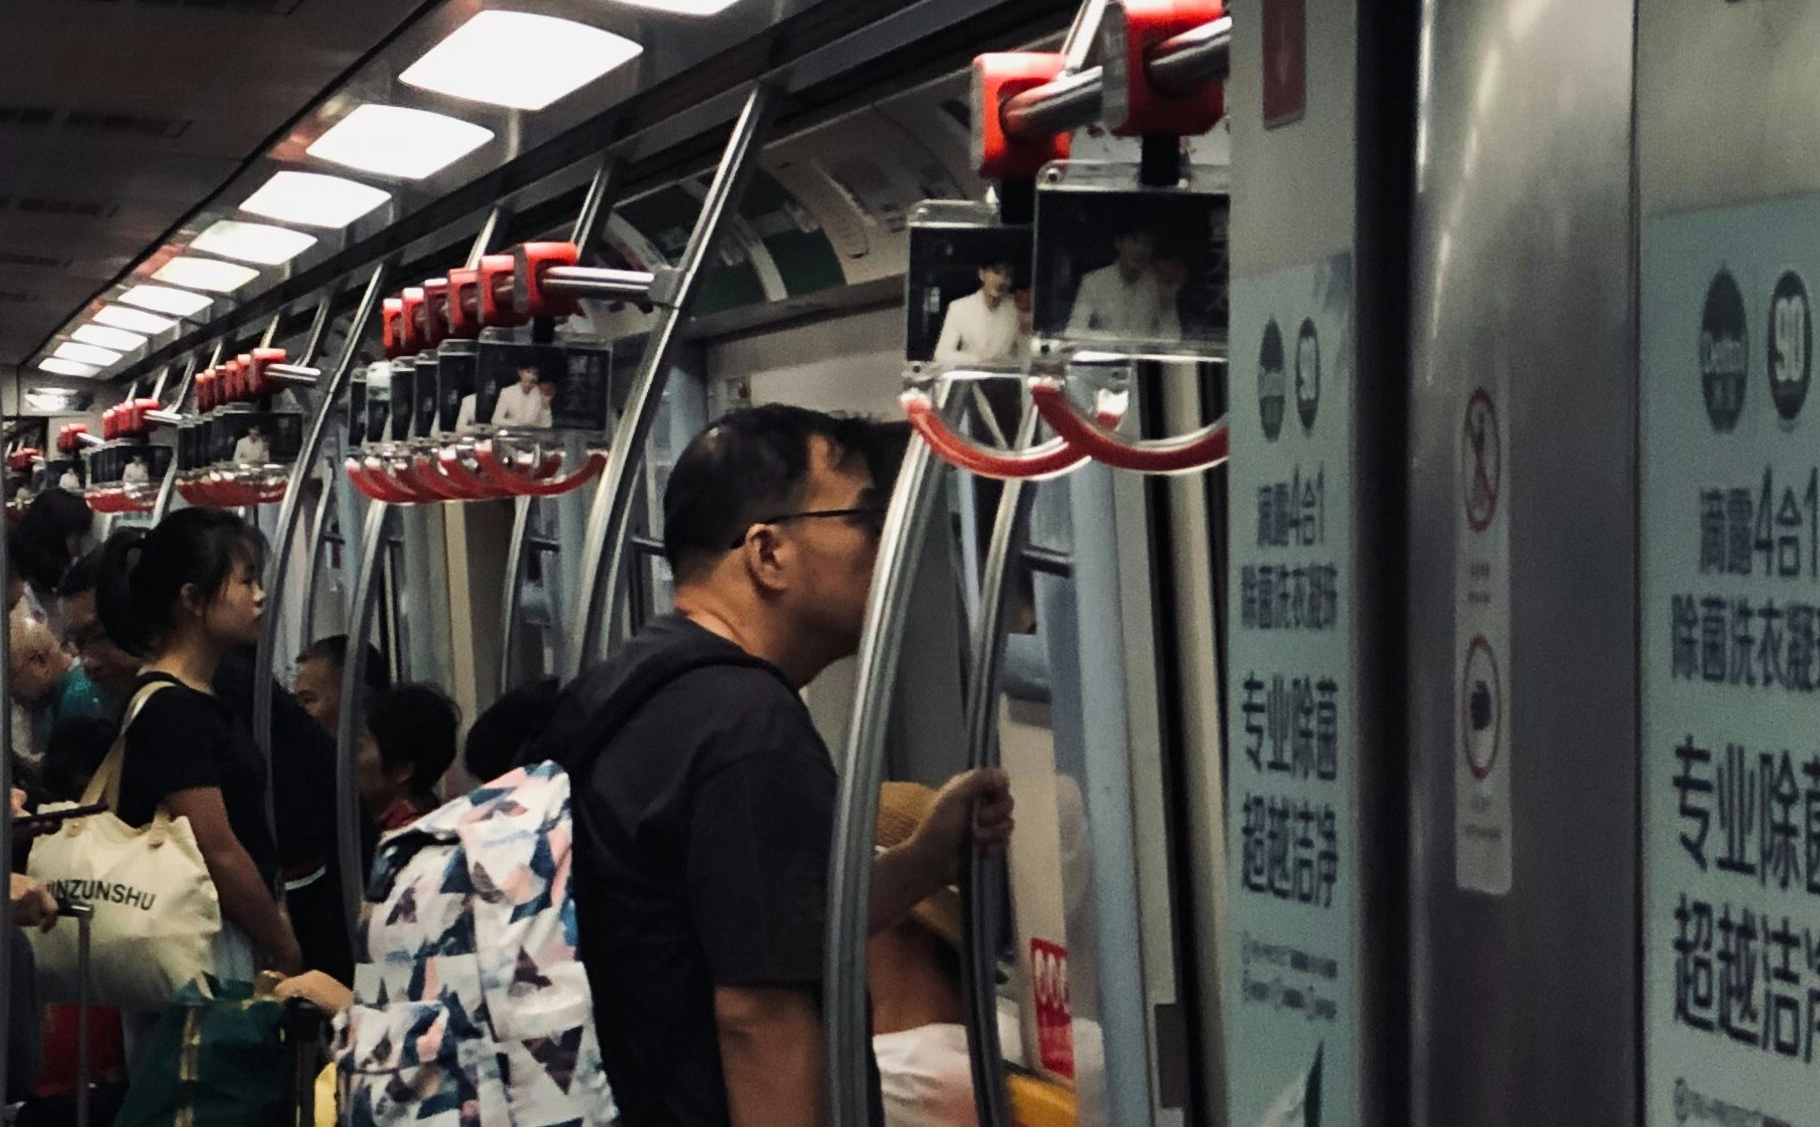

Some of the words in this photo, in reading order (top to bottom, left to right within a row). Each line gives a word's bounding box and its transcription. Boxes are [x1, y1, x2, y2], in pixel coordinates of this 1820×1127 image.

[1672, 592, 1820, 692] 除菌洗衣凝
[1242, 670, 1338, 780] 专业除菌
[1241, 791, 1338, 909] 超越洁净
